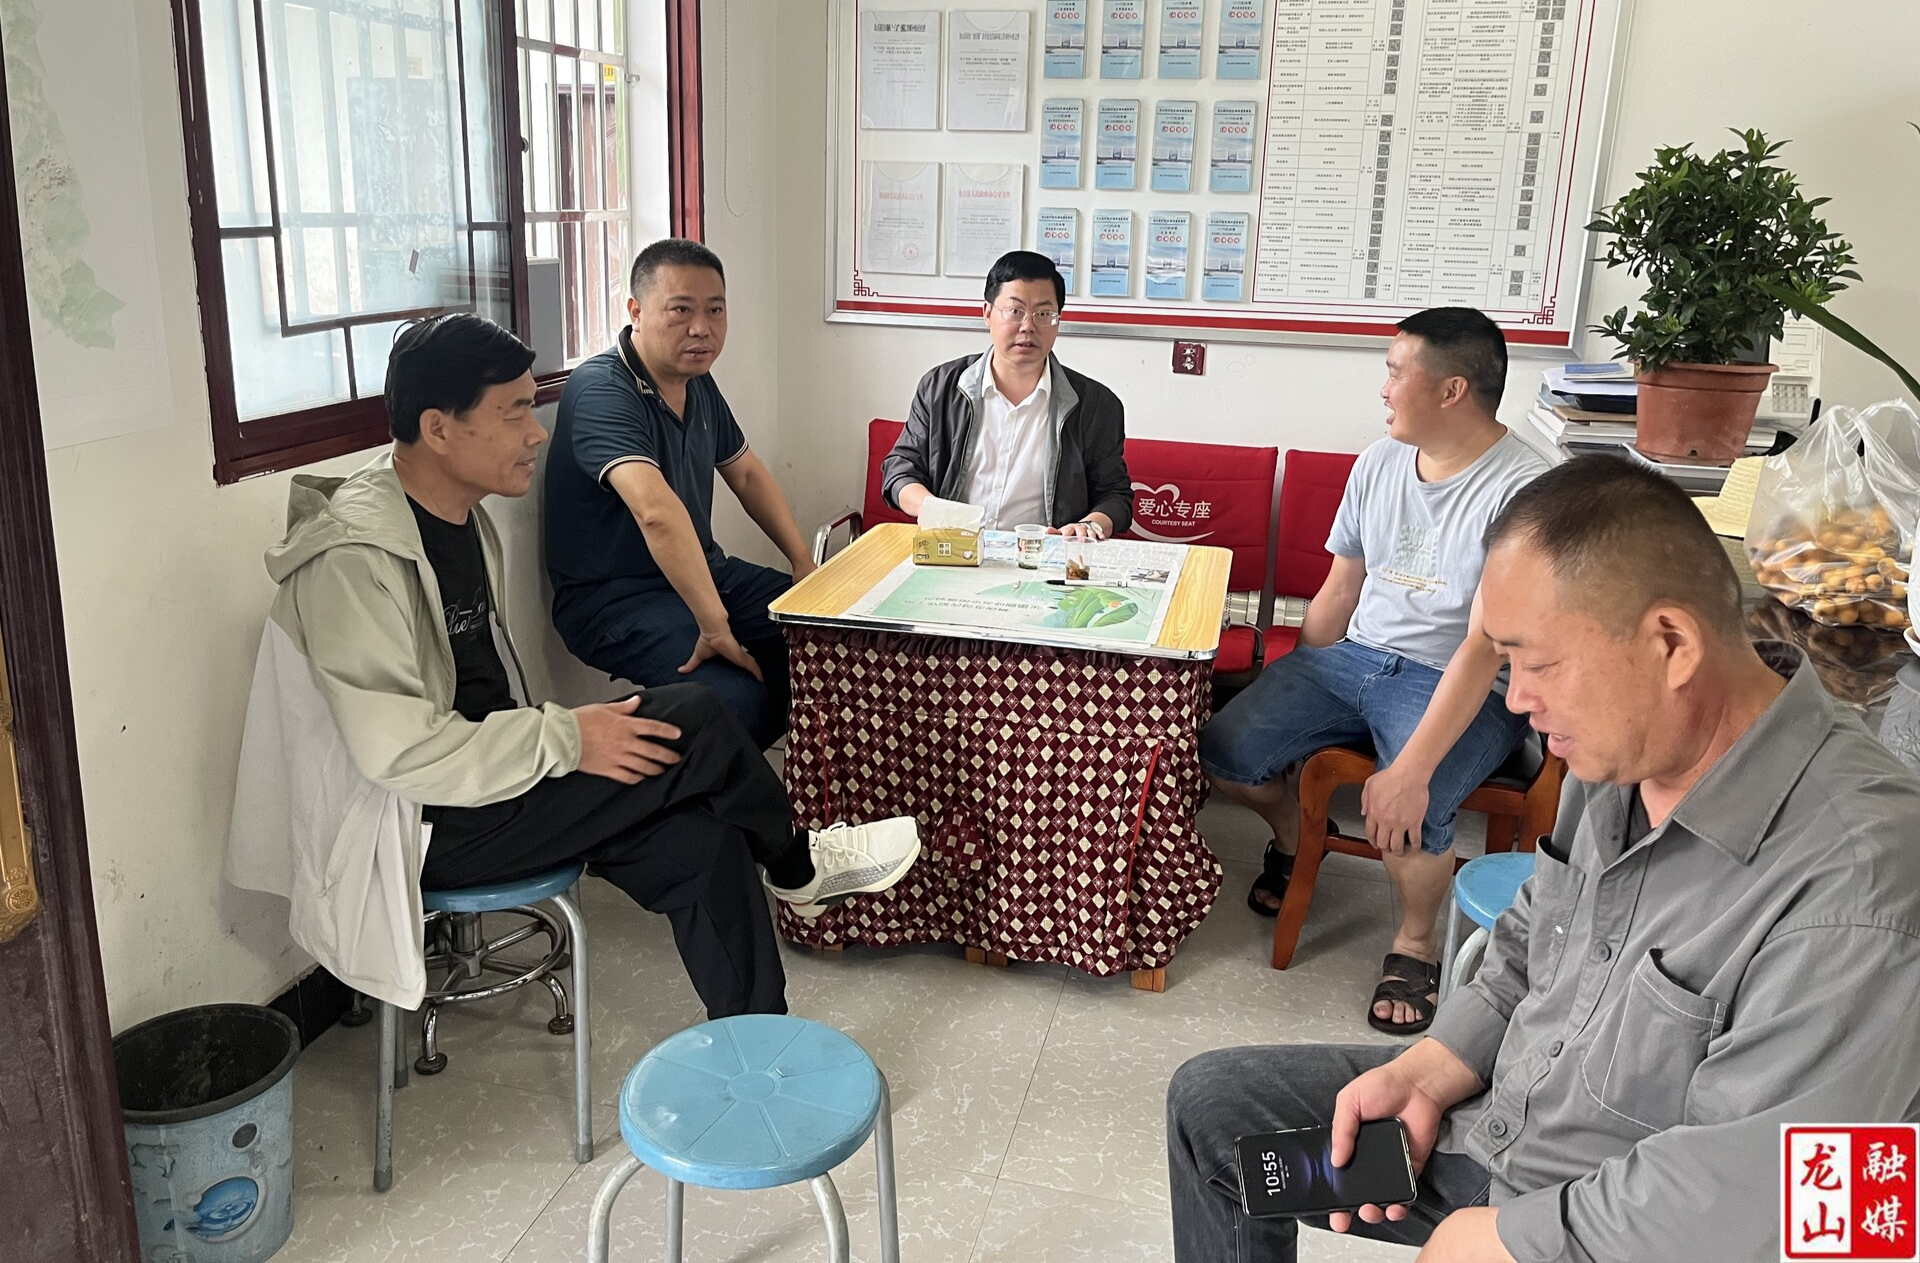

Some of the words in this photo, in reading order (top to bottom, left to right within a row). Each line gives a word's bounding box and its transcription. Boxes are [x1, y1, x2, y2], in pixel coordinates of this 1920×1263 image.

[1138, 498, 1212, 518] 爱心专座
[1261, 1150, 1281, 1196] 10:55
